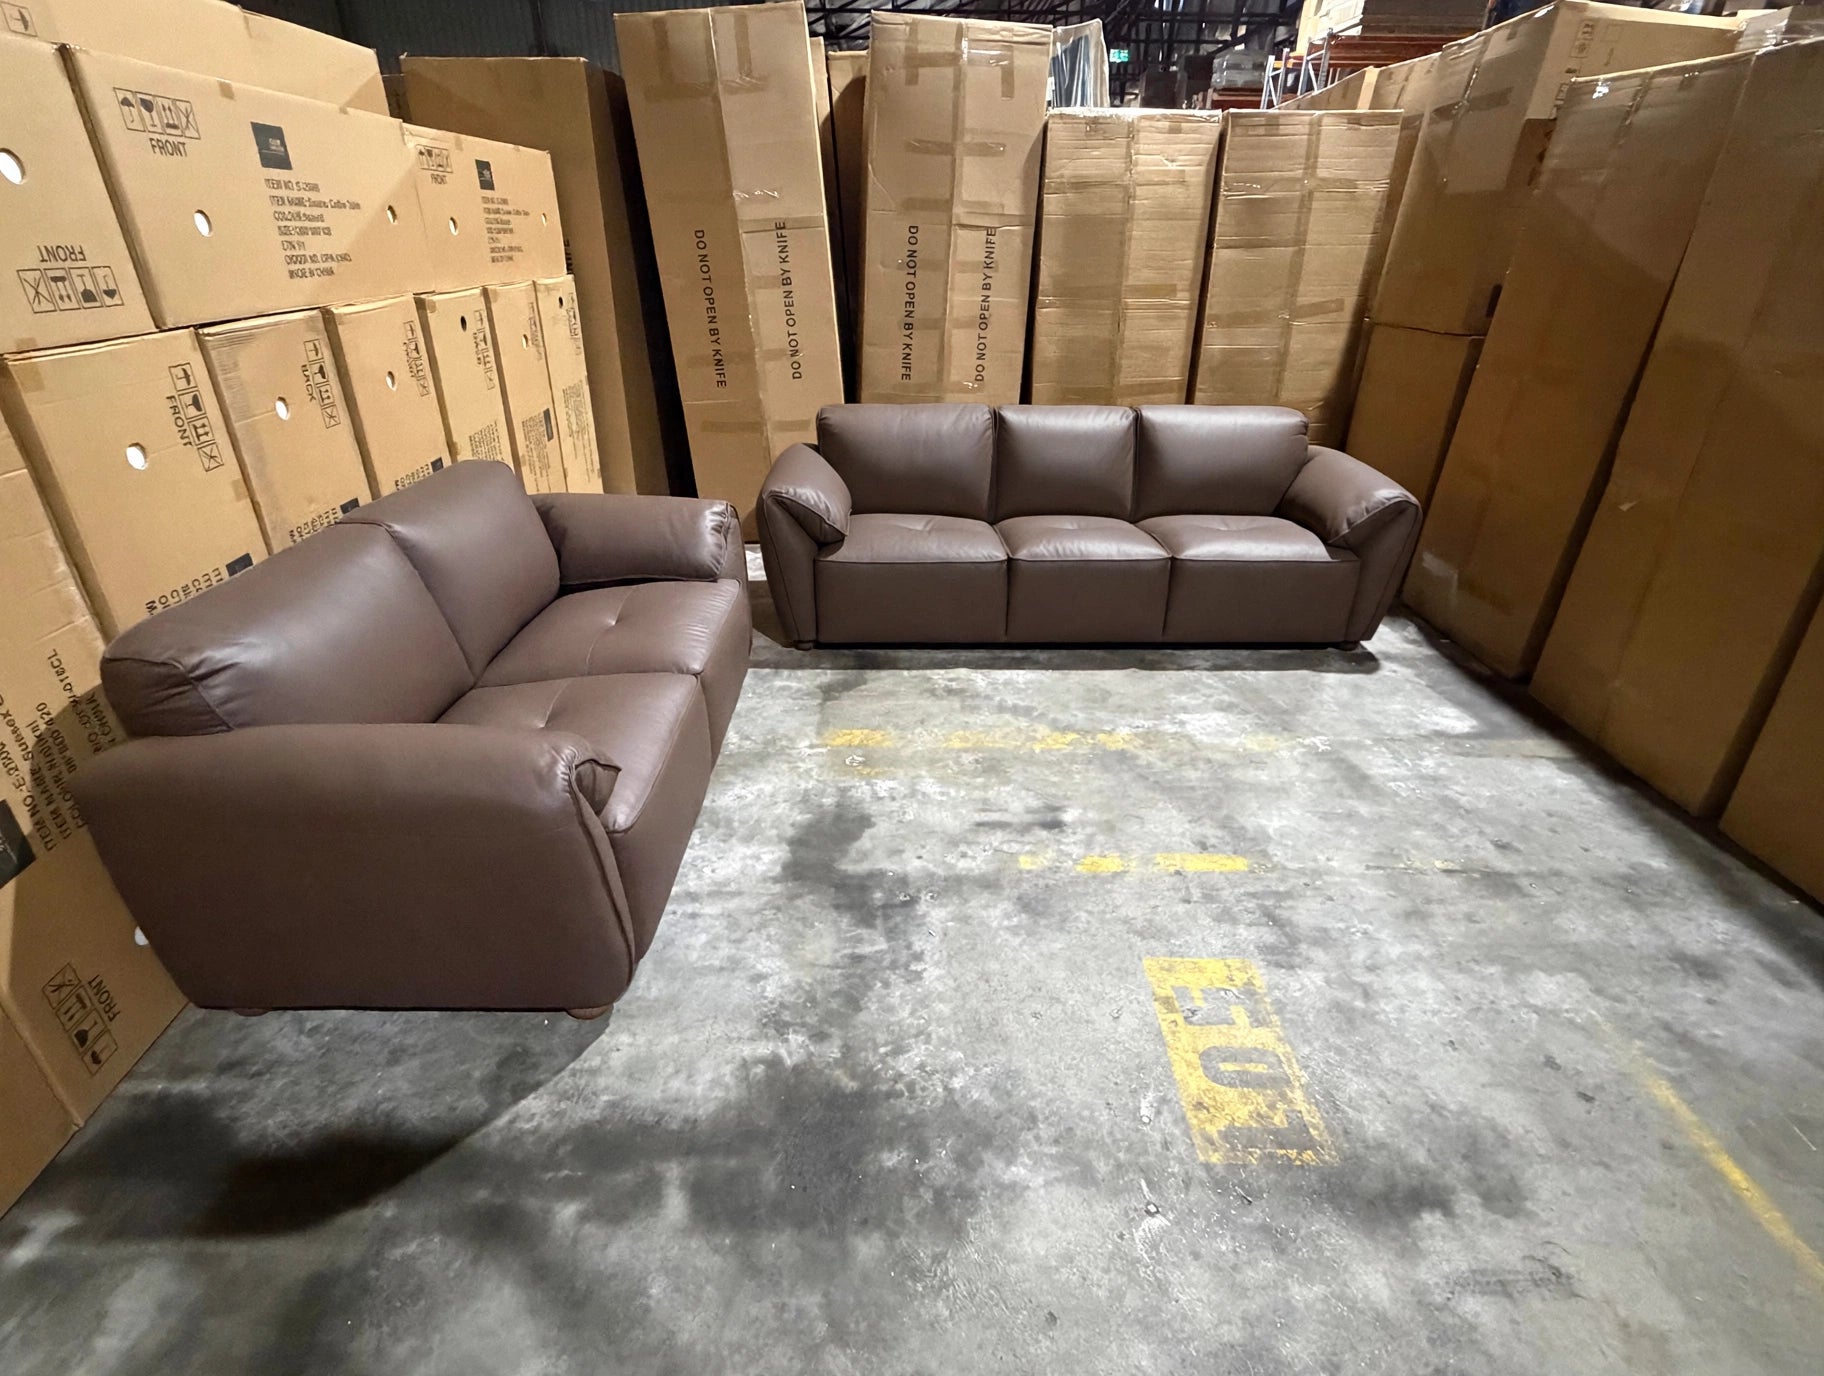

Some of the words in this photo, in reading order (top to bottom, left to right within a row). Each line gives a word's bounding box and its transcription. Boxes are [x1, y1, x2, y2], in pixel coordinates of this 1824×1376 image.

[149, 138, 188, 157] FRONT
[695, 230, 706, 250] DO
[775, 221, 790, 264] KNIFE
[908, 225, 918, 246] DO
[983, 228, 997, 269] KNIFE
[37, 245, 87, 263] FRONT
[906, 249, 917, 278] NOT
[698, 254, 711, 283] NOT
[780, 269, 792, 286] BY
[981, 273, 993, 291] BY
[703, 286, 717, 324] OPEN
[783, 290, 796, 328] OPEN
[904, 281, 916, 319] OPEN
[978, 294, 990, 331] OPEN
[709, 328, 721, 345] BY
[787, 331, 799, 357] NOT
[903, 322, 914, 341] BY
[976, 333, 987, 361] NOT
[712, 349, 727, 388] KNIFE
[791, 361, 802, 380] DO
[901, 343, 913, 381] KNIFE
[975, 364, 985, 382] DO
[165, 394, 193, 447] FRONT
[87, 974, 121, 1022] FRONT
